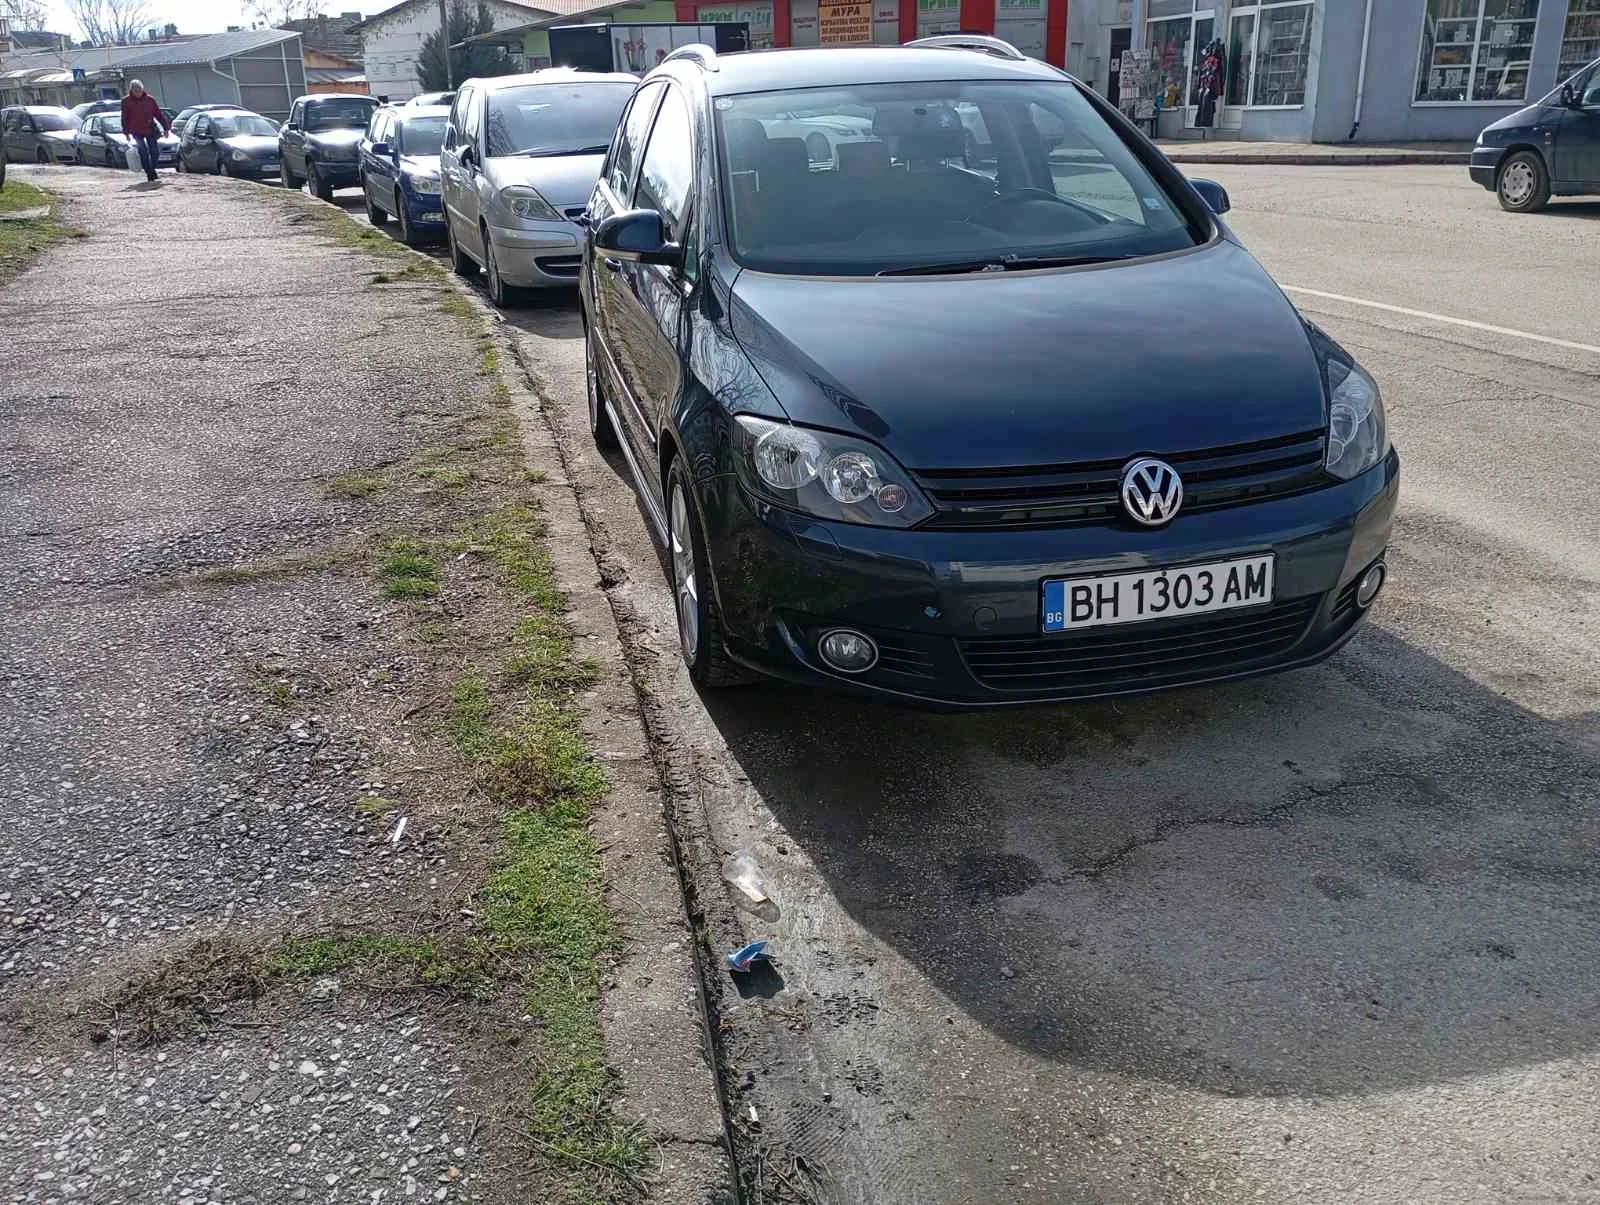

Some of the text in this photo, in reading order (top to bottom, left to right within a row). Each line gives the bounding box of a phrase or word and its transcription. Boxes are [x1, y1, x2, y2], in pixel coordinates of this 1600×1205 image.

[1123, 458, 1183, 526] VW
[1046, 612, 1063, 624] BG
[1070, 562, 1267, 622] BH 1303 AM
